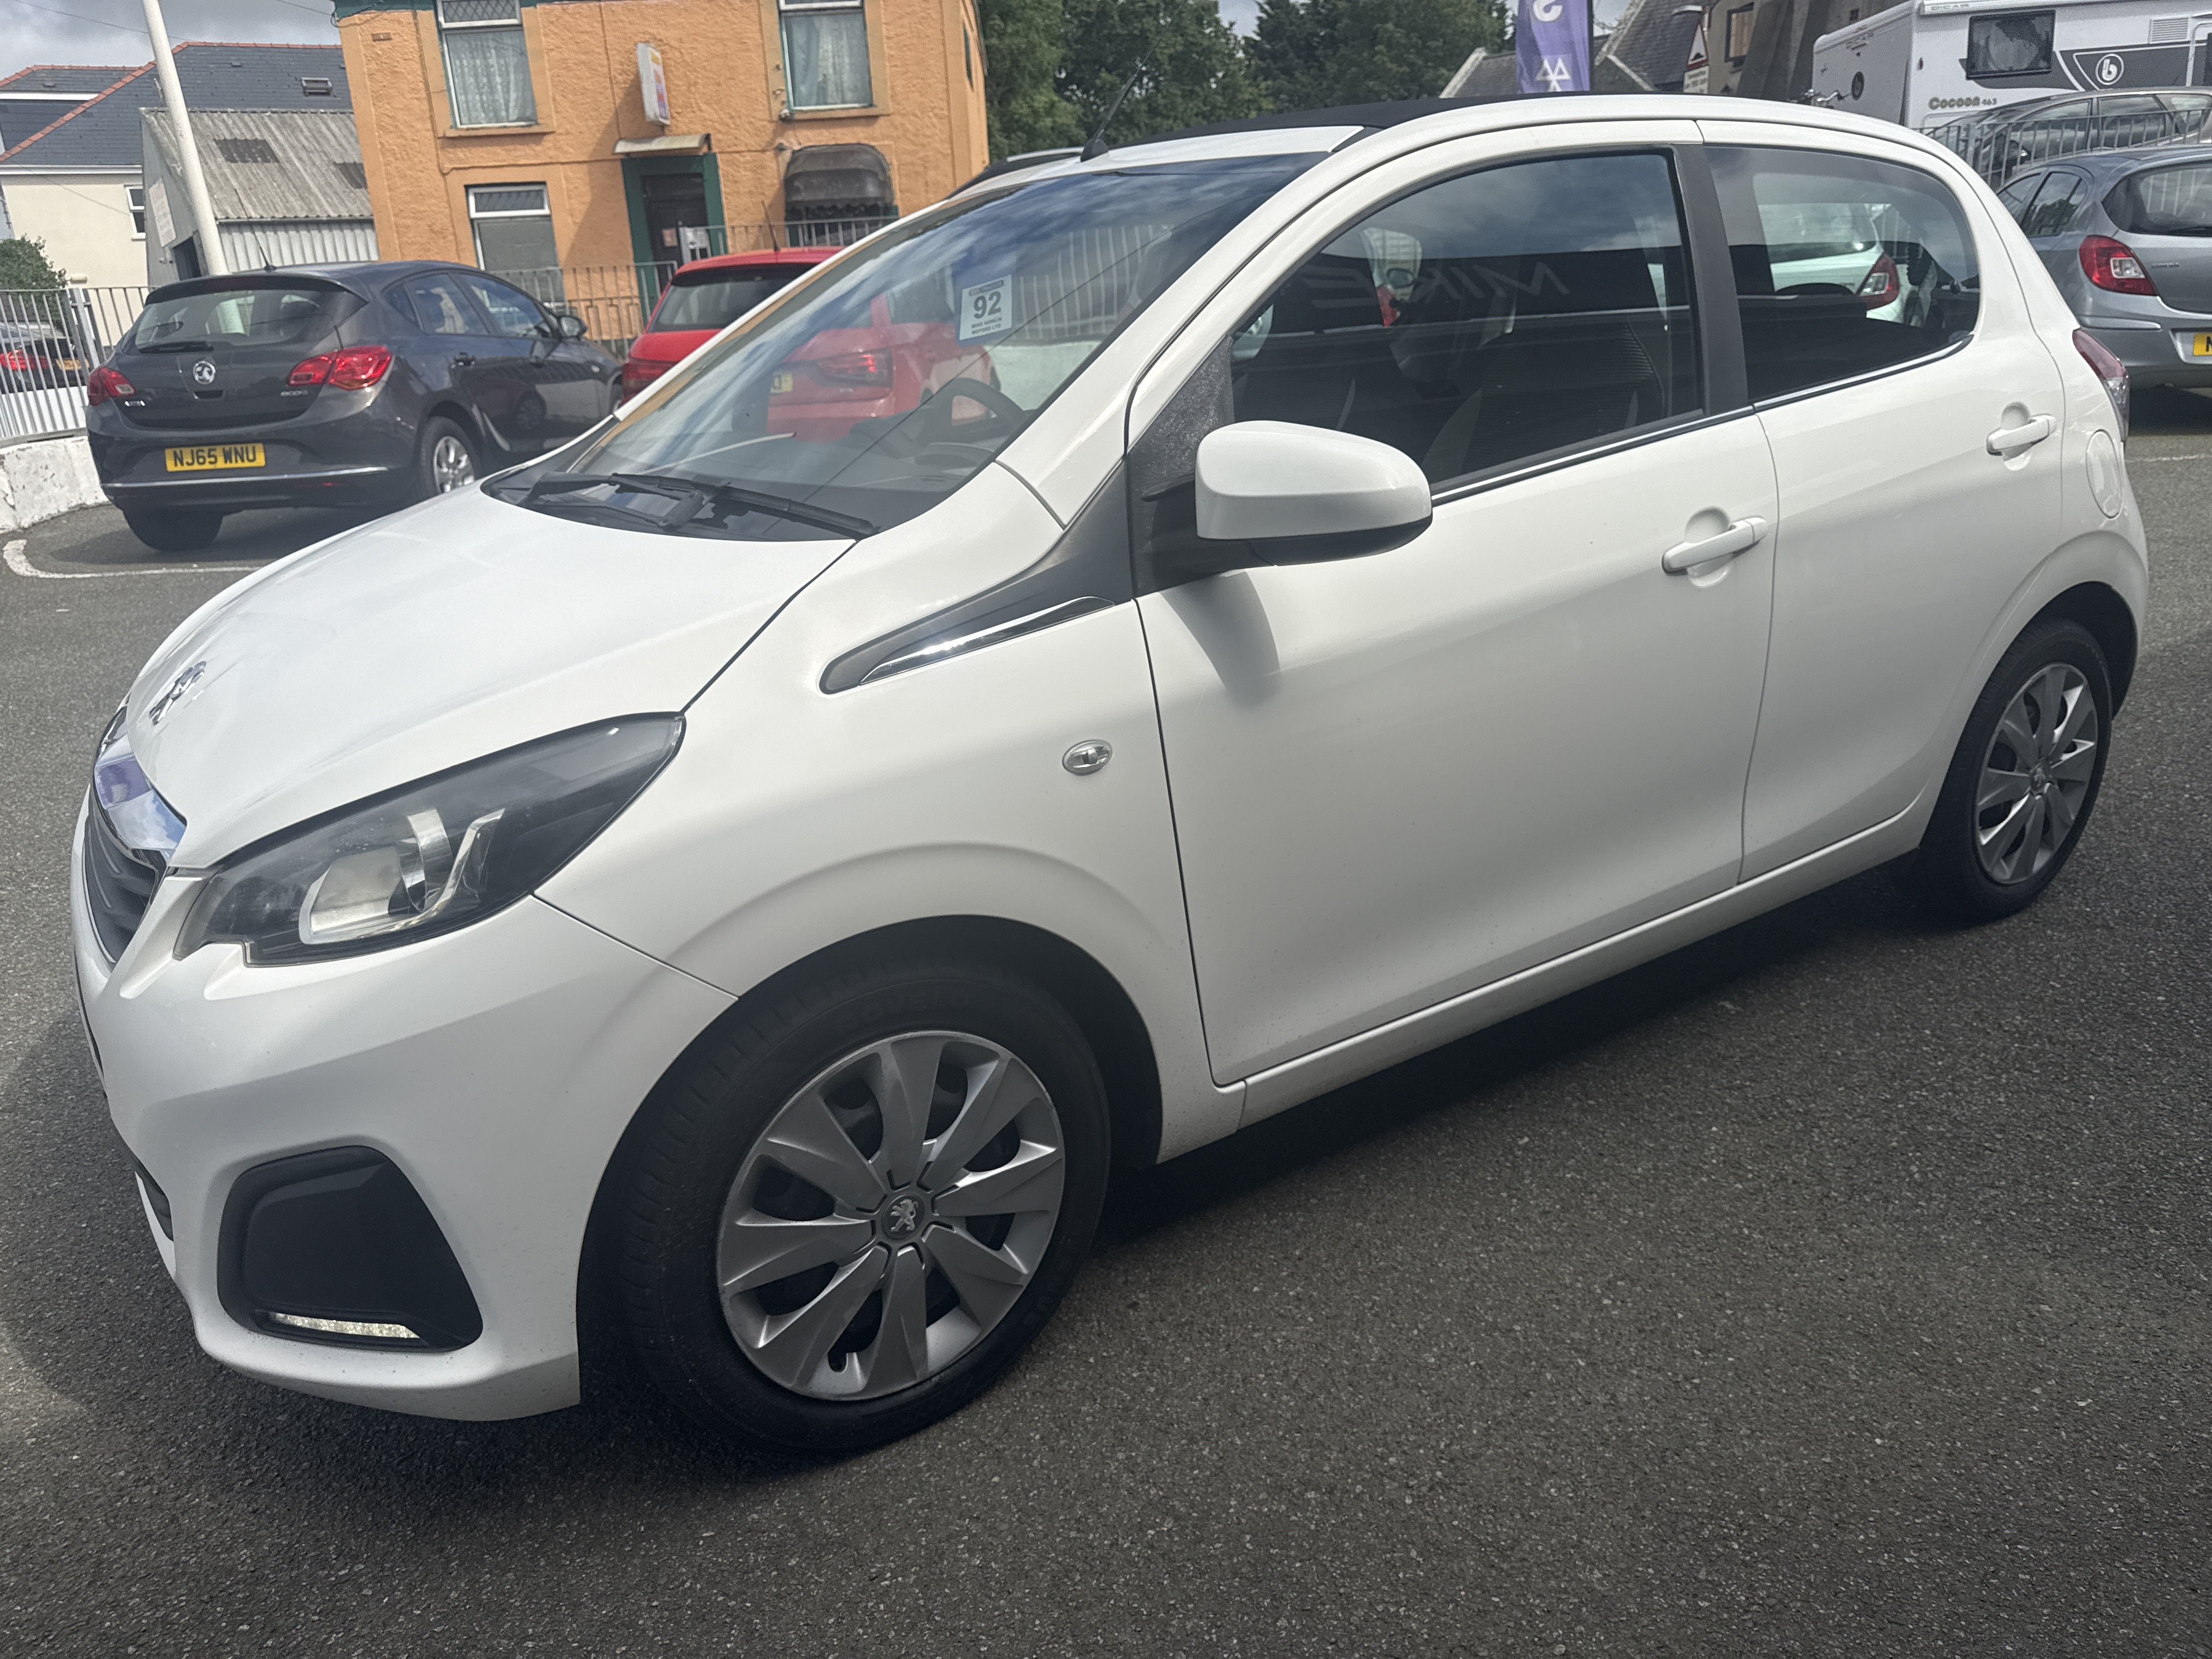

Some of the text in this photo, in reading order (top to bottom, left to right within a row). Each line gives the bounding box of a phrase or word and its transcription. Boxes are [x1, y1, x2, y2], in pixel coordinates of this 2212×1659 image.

[973, 291, 1002, 319] 92
[173, 445, 257, 467] NJ65 WNU
